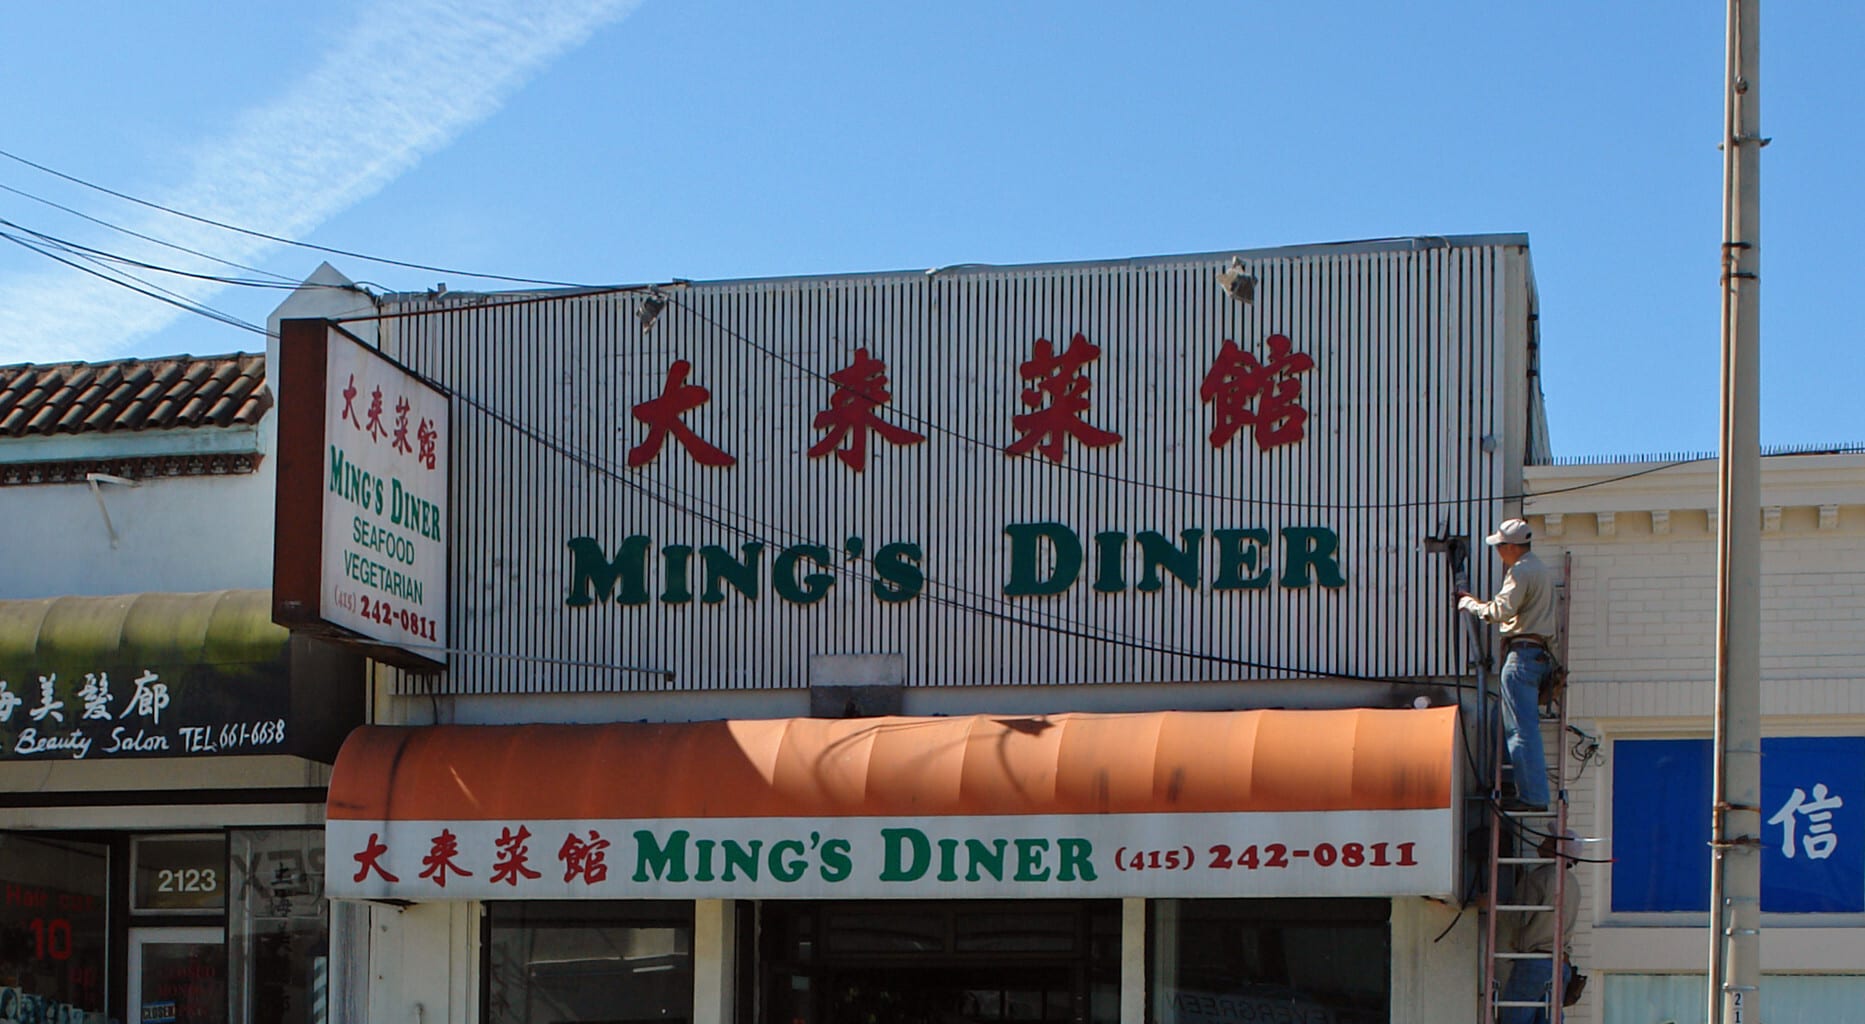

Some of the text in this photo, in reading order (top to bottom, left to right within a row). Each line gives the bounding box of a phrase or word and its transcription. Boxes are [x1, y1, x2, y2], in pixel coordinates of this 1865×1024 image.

[330, 443, 441, 542] MING'S DINER
[353, 516, 415, 566] SEAFOOD
[566, 522, 1347, 607] MING'S DINER
[344, 549, 423, 606] VEGETARIAN
[334, 584, 437, 642] (415) 242-0811
[14, 727, 93, 759] Beauty
[102, 726, 170, 753] Salon
[219, 718, 286, 749] 661-6638
[1767, 783, 1843, 860] 信
[158, 869, 217, 892] 2123
[632, 829, 852, 883] MING'S
[879, 828, 1098, 882] DINER
[1114, 847, 1195, 871] (415)
[1208, 842, 1418, 869] 242-0811
[31, 918, 72, 961] 10
